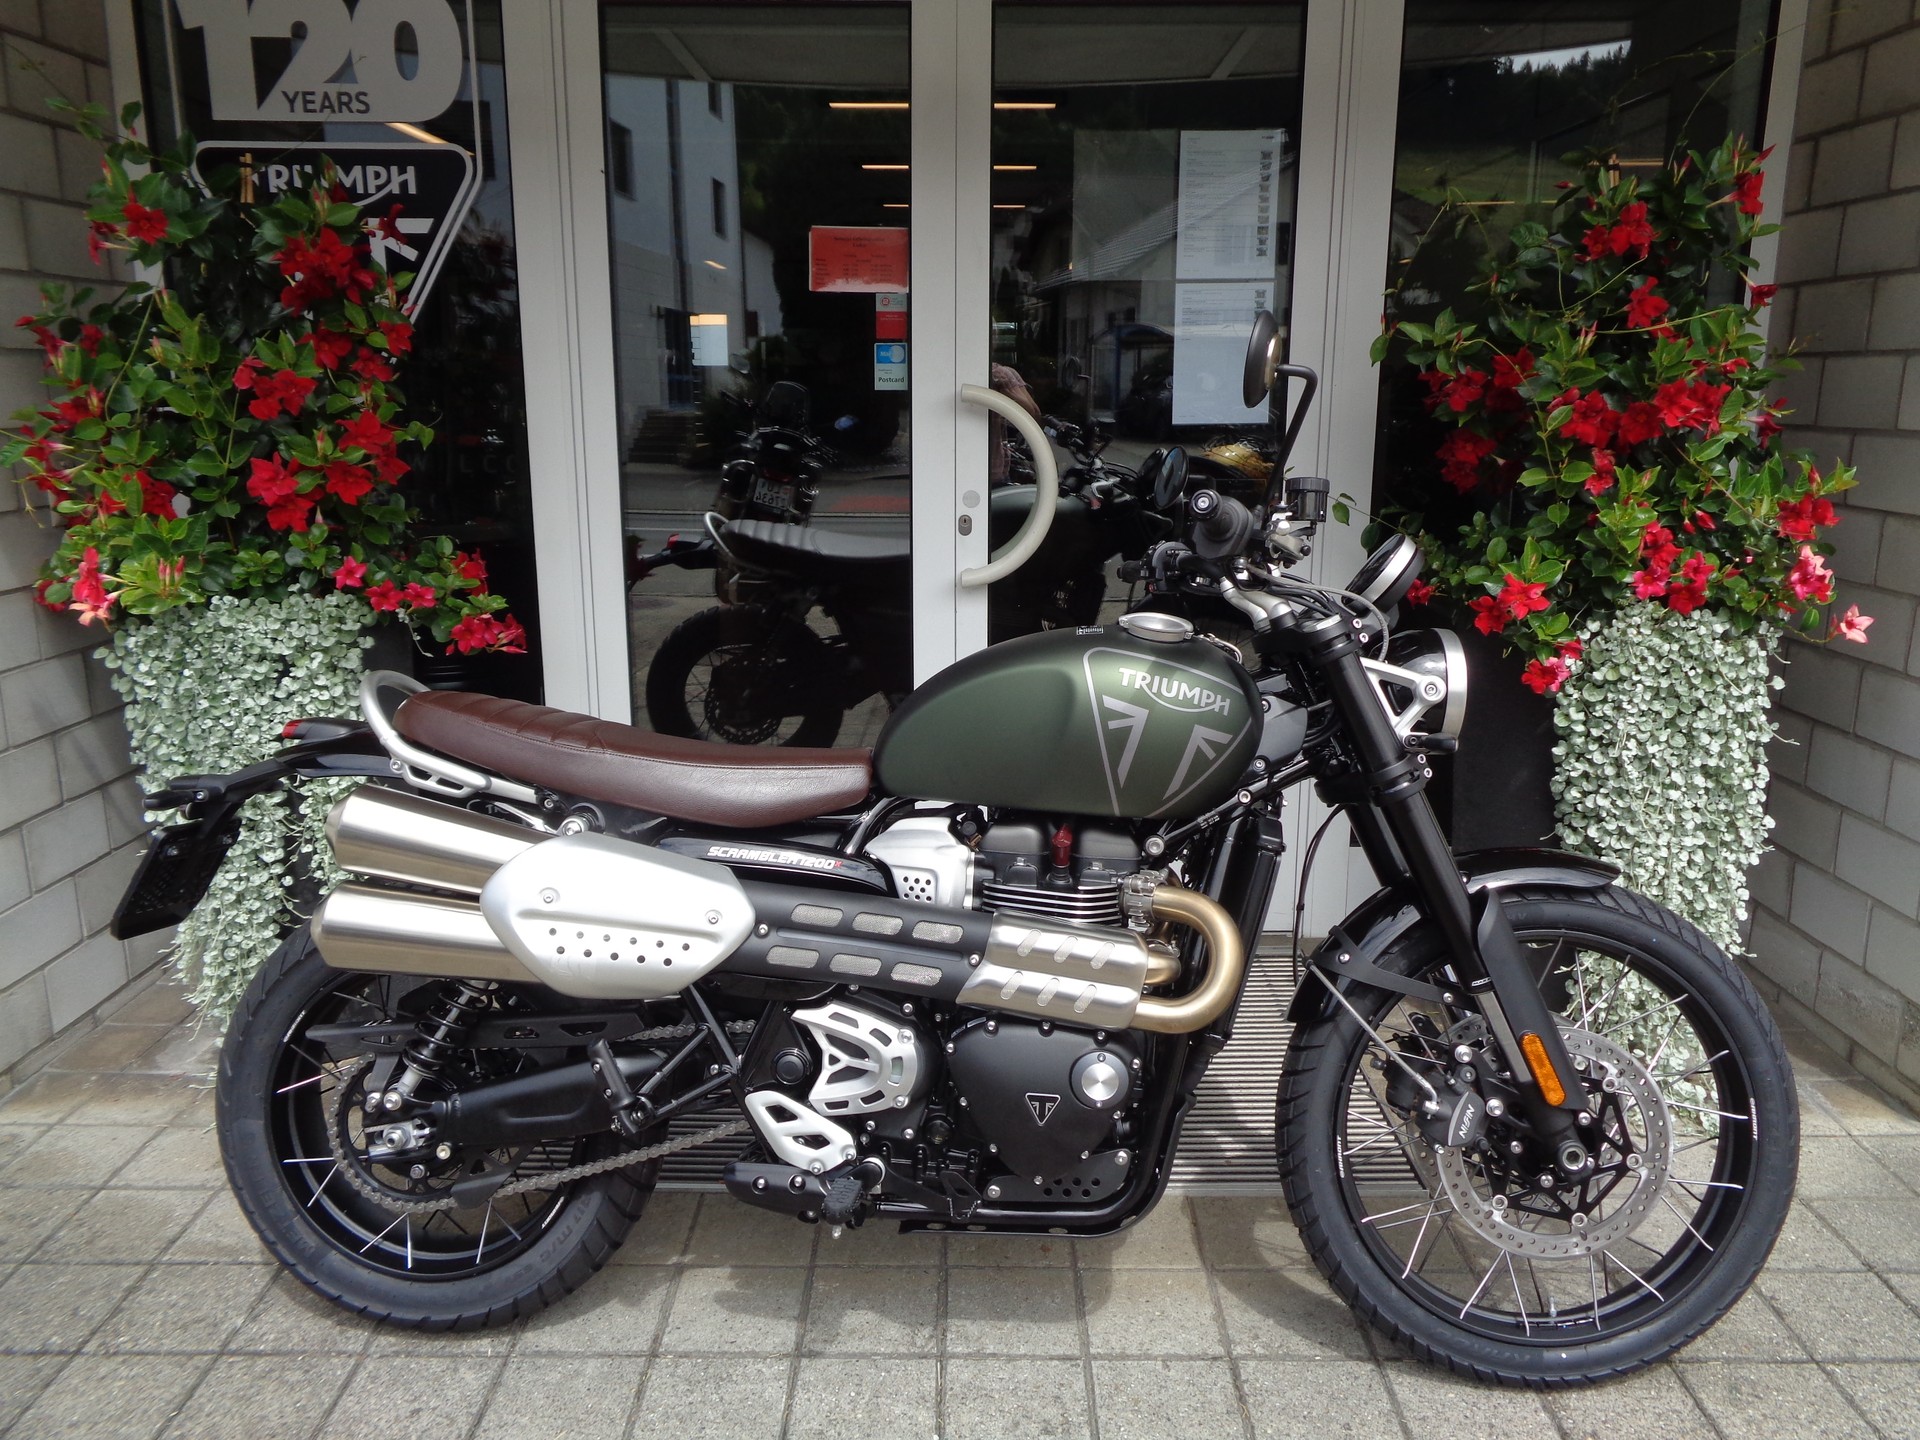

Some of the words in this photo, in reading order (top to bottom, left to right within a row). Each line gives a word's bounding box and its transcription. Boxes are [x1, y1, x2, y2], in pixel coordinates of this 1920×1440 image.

[173, 0, 463, 121] 120
[281, 90, 371, 115] YEARS
[1118, 667, 1231, 716] TRIUMPH
